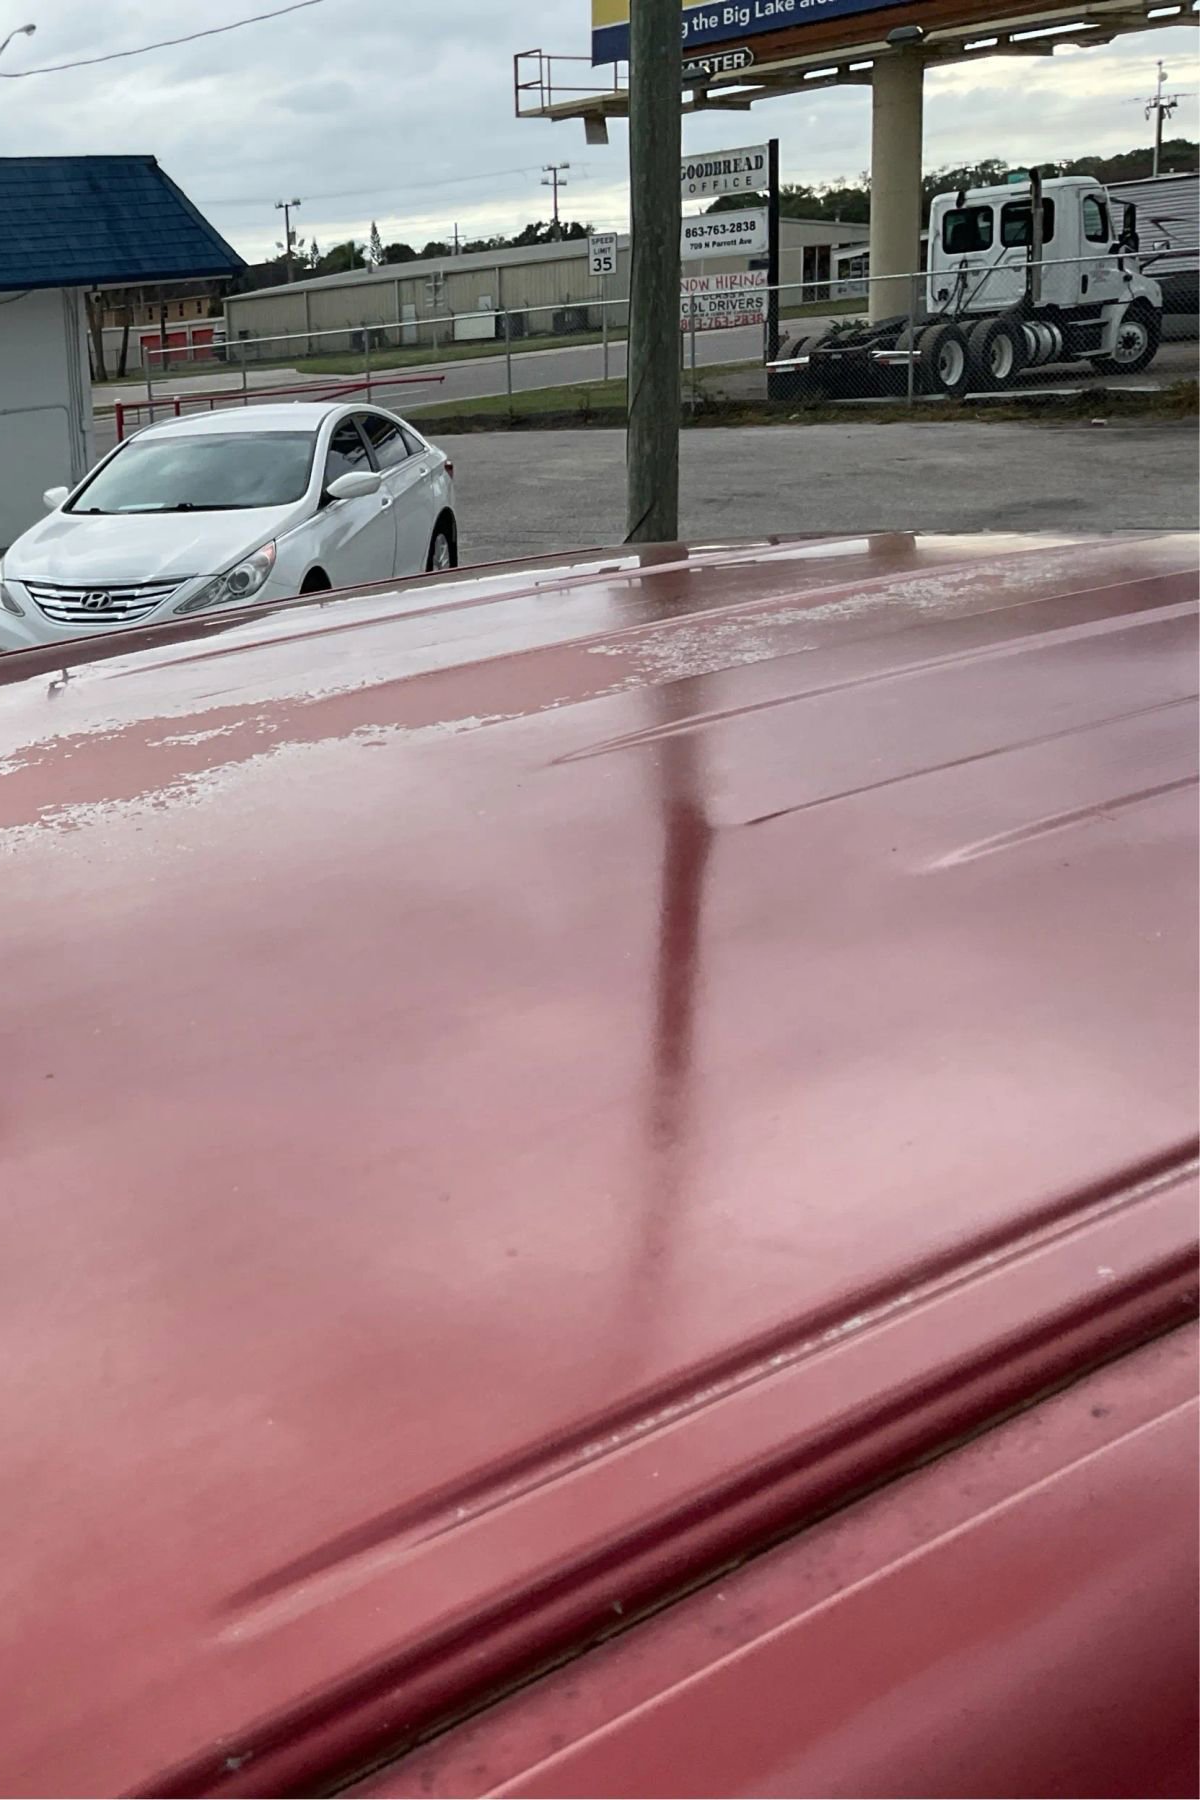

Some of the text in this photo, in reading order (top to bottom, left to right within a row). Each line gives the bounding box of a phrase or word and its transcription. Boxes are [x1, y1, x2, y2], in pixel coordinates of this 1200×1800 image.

[692, 13, 718, 30] the
[723, 6, 750, 26] Big
[755, 0, 794, 17] Lake
[689, 176, 752, 193] OFFICE
[685, 221, 756, 238] 863-763-2838
[591, 236, 614, 245] SPEED
[593, 247, 611, 255] LIMIT
[593, 257, 612, 272] 35
[680, 272, 765, 292] NOW HIRING
[709, 297, 763, 311] DRIVERS
